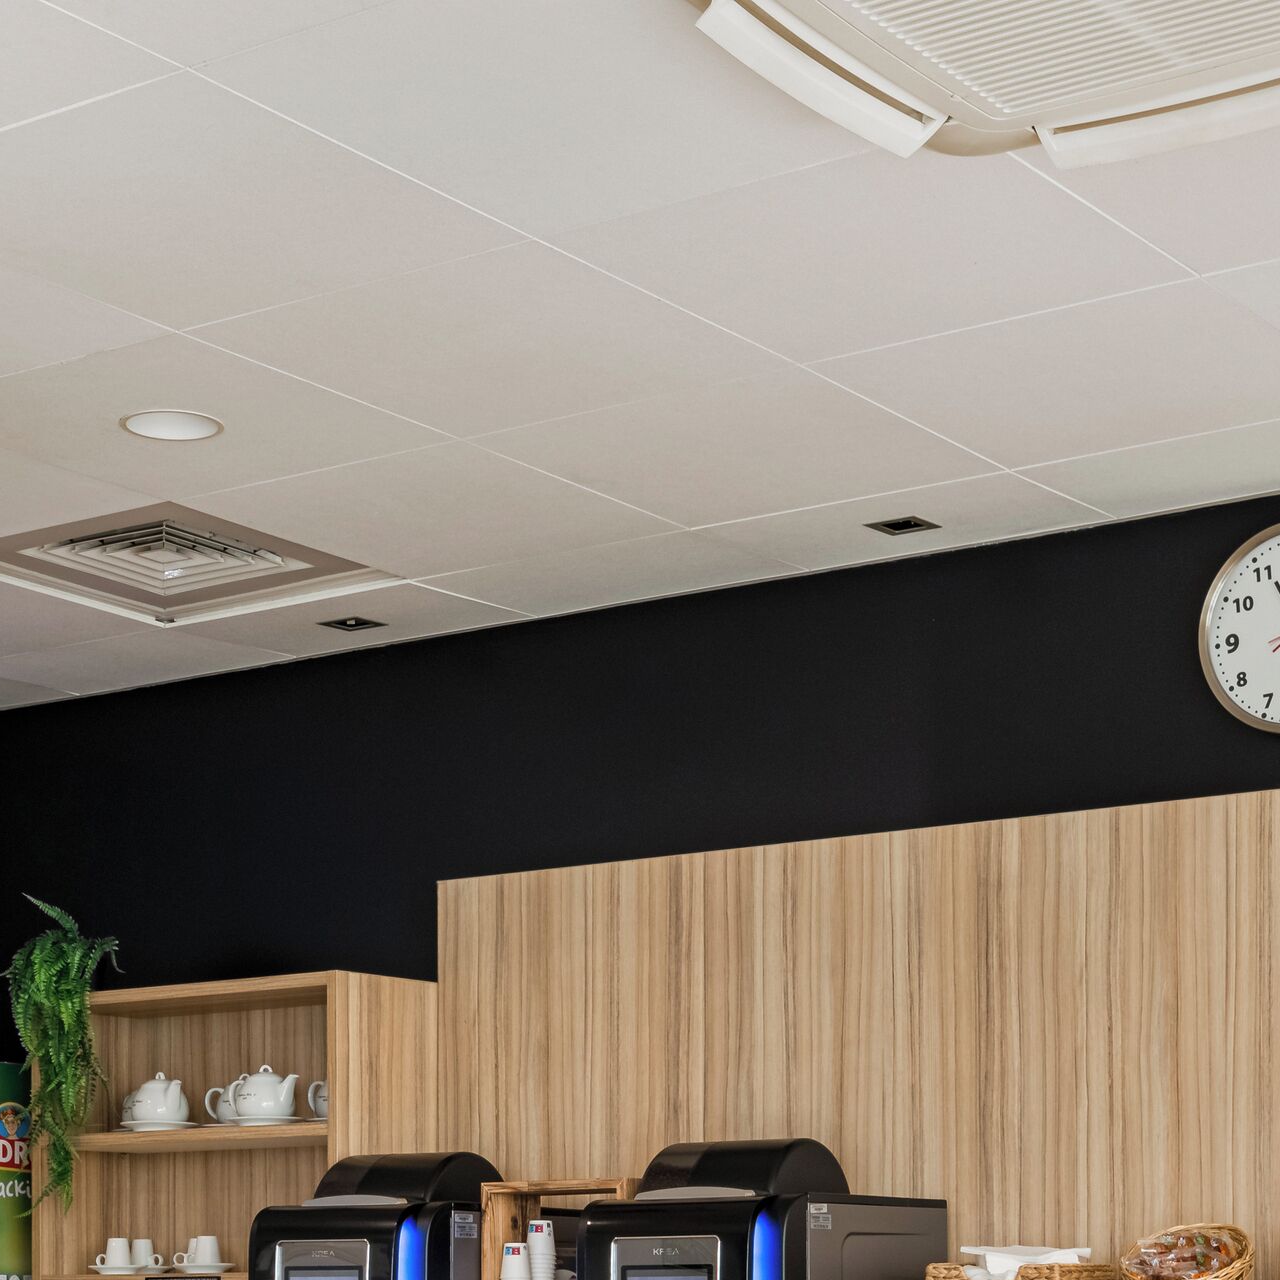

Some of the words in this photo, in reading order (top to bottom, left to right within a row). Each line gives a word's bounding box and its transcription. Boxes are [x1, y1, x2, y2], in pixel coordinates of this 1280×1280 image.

[1253, 565, 1272, 582] 11
[1233, 595, 1254, 613] 10
[1225, 633, 1240, 653] 9
[1236, 672, 1248, 687] 8
[1263, 693, 1274, 709] 7
